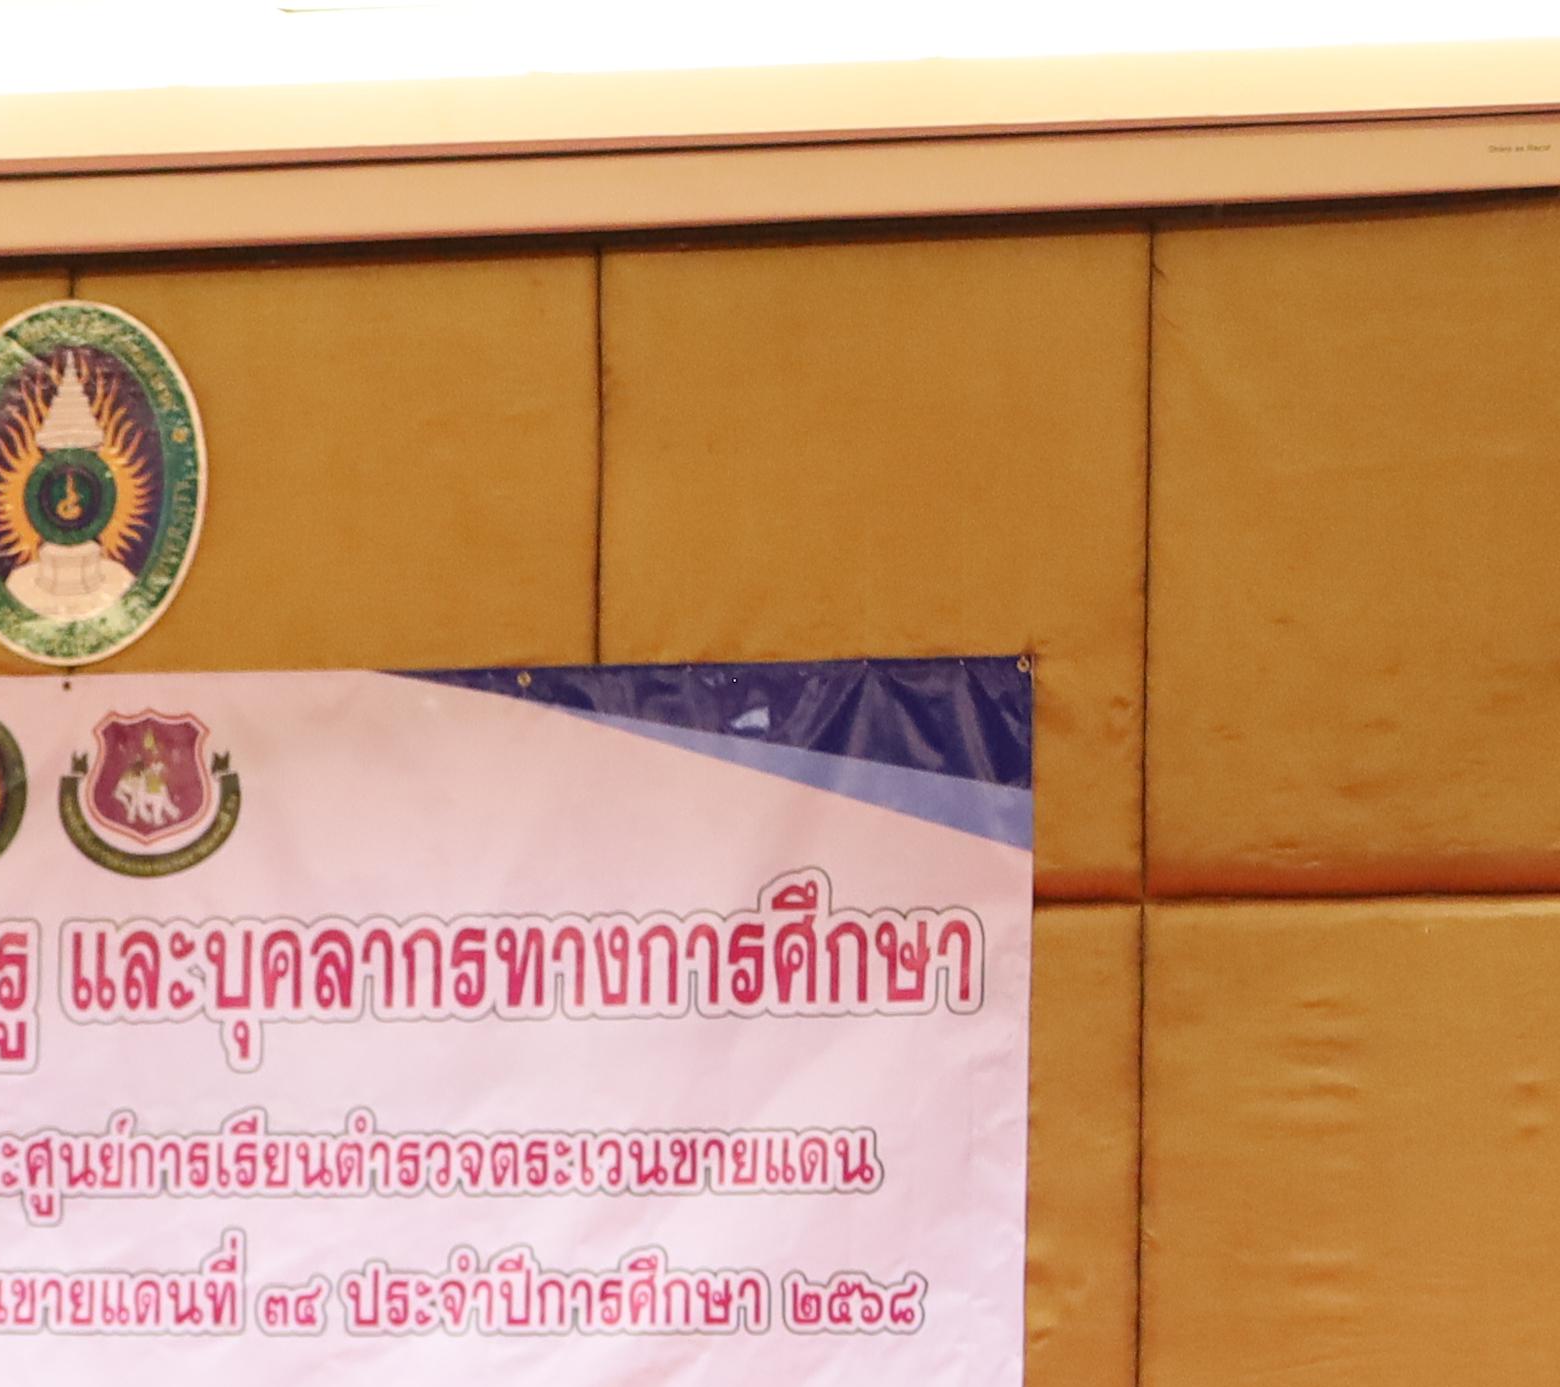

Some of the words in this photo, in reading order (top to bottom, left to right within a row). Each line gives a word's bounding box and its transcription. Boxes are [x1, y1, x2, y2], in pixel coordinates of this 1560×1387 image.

[71, 880, 974, 1060] และบุคลากรทางการศึกษา
[347, 1254, 762, 1328] ประจำปีการศึกษา
[790, 1279, 919, 1327] ๒๕๖๘
